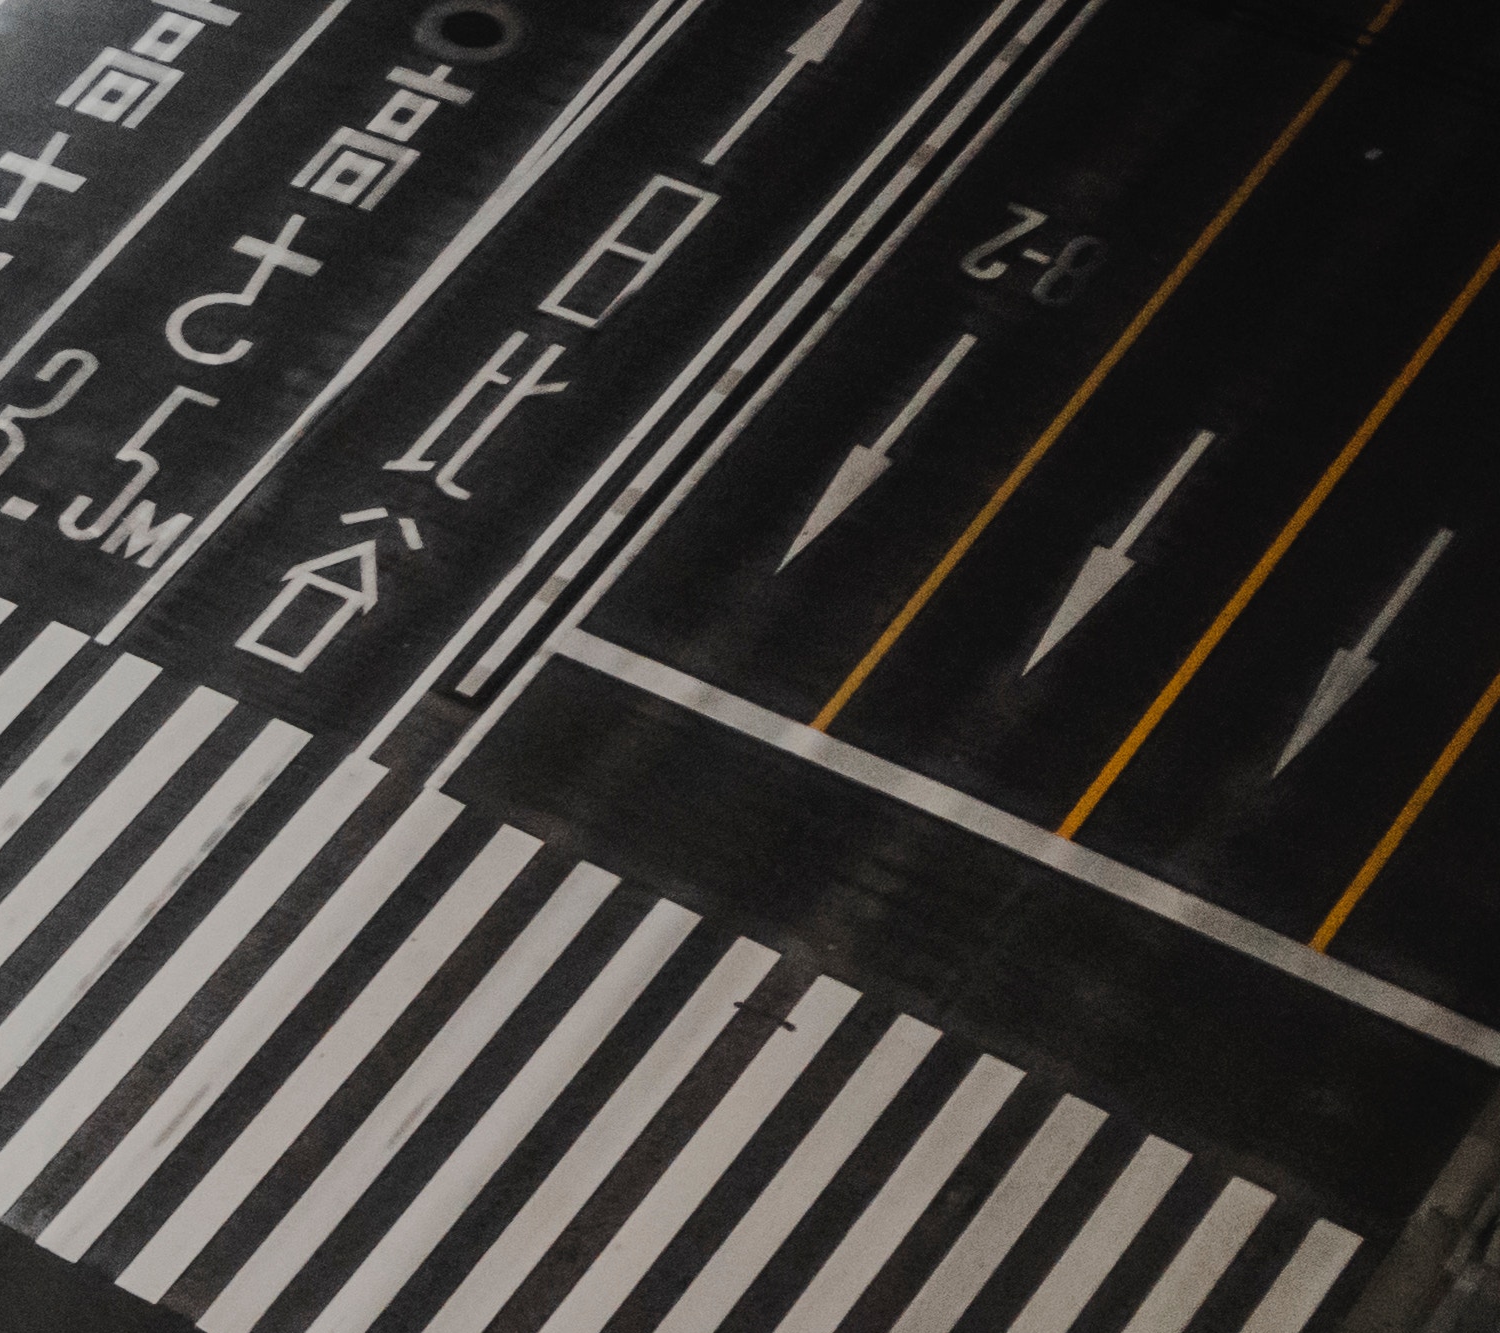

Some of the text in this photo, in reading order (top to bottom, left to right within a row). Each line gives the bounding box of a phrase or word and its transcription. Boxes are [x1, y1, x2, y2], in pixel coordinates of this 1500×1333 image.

[165, 64, 475, 364] 高さ
[234, 174, 722, 672] 日比谷
